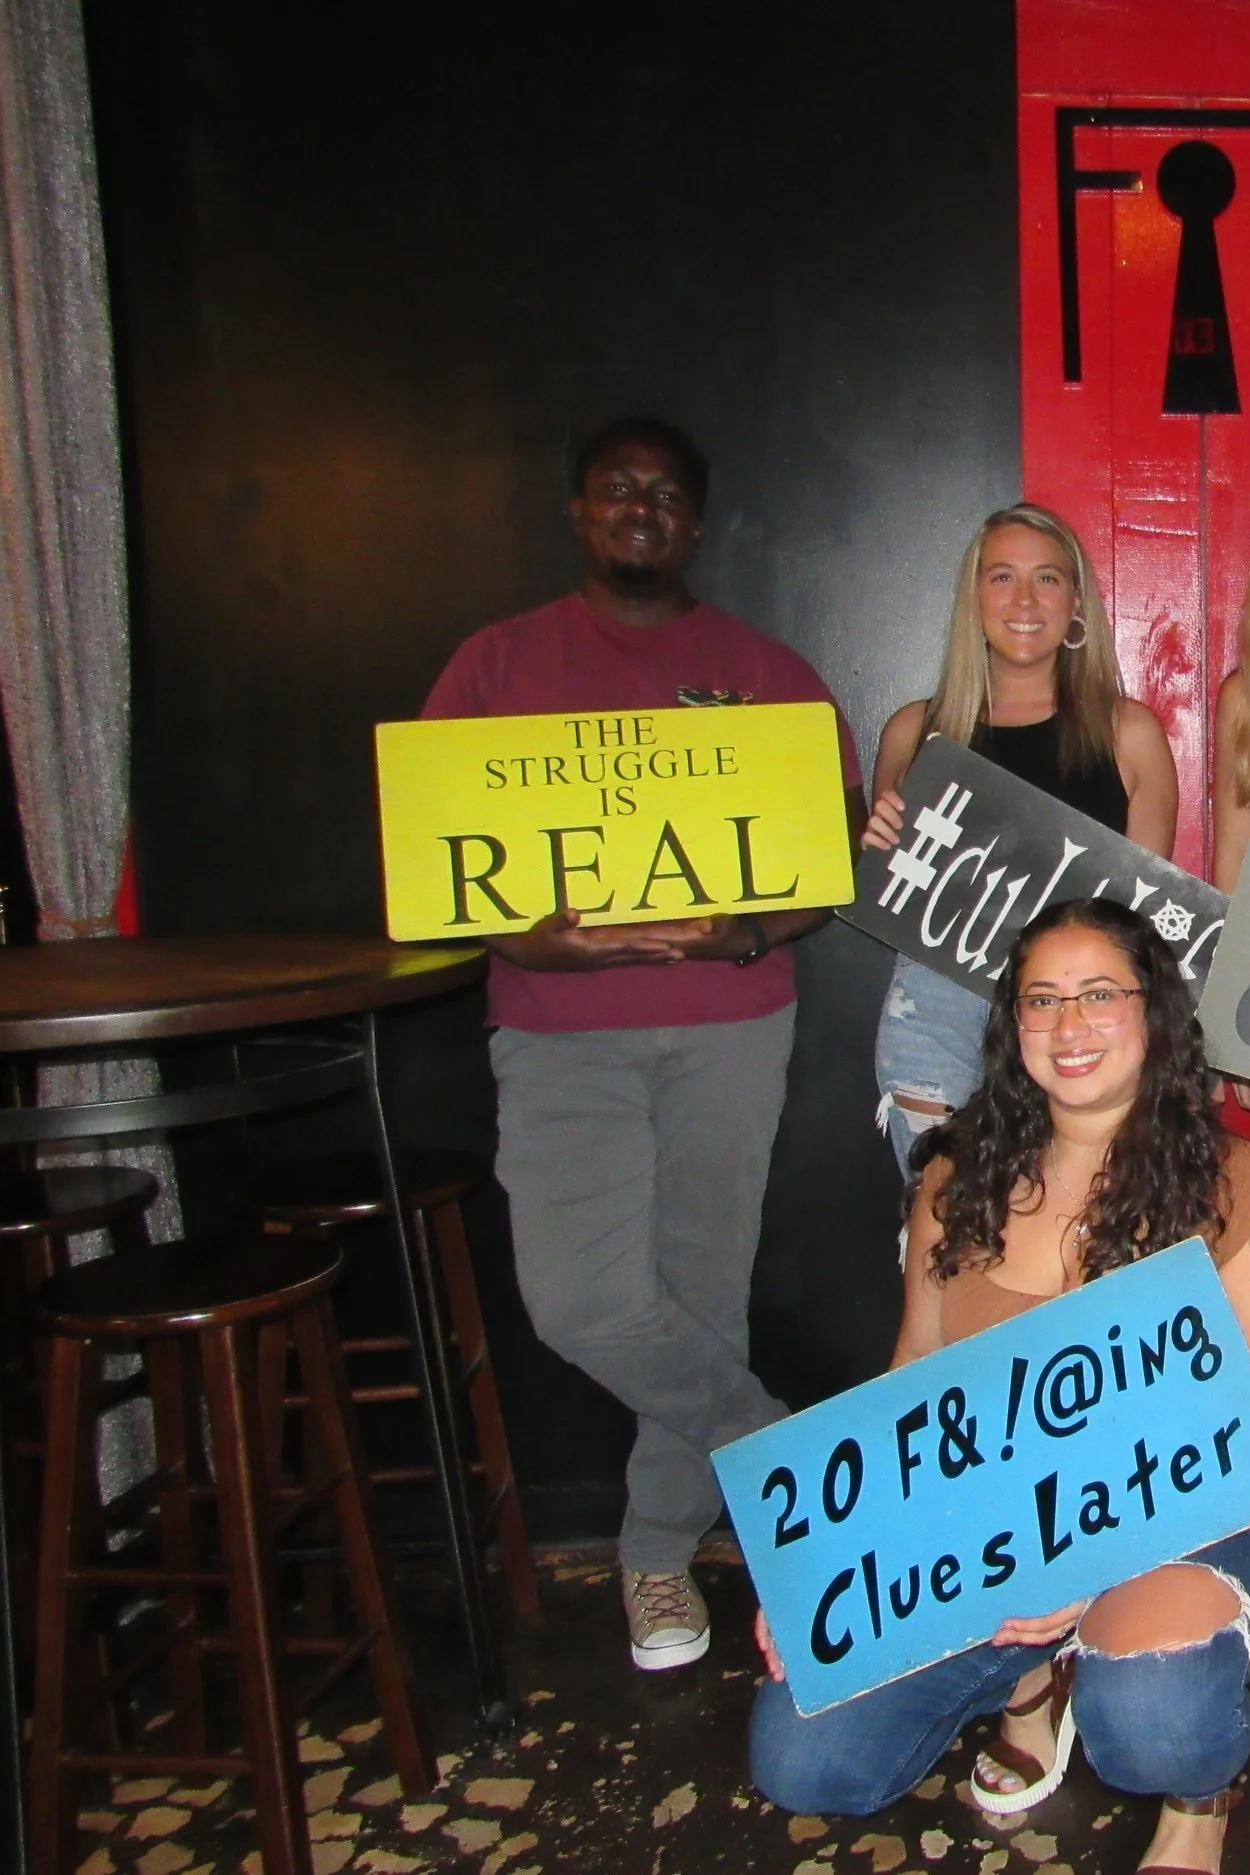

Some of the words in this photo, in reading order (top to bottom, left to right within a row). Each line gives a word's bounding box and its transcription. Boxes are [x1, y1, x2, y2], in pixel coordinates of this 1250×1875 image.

[485, 746, 739, 789] STRUGGLE
[564, 716, 658, 749] THE
[600, 786, 637, 817] IS
[437, 815, 800, 926] REAL
[761, 1437, 863, 1548] 20
[810, 1530, 1017, 1665] Clues
[1034, 1417, 1241, 1566] Later
